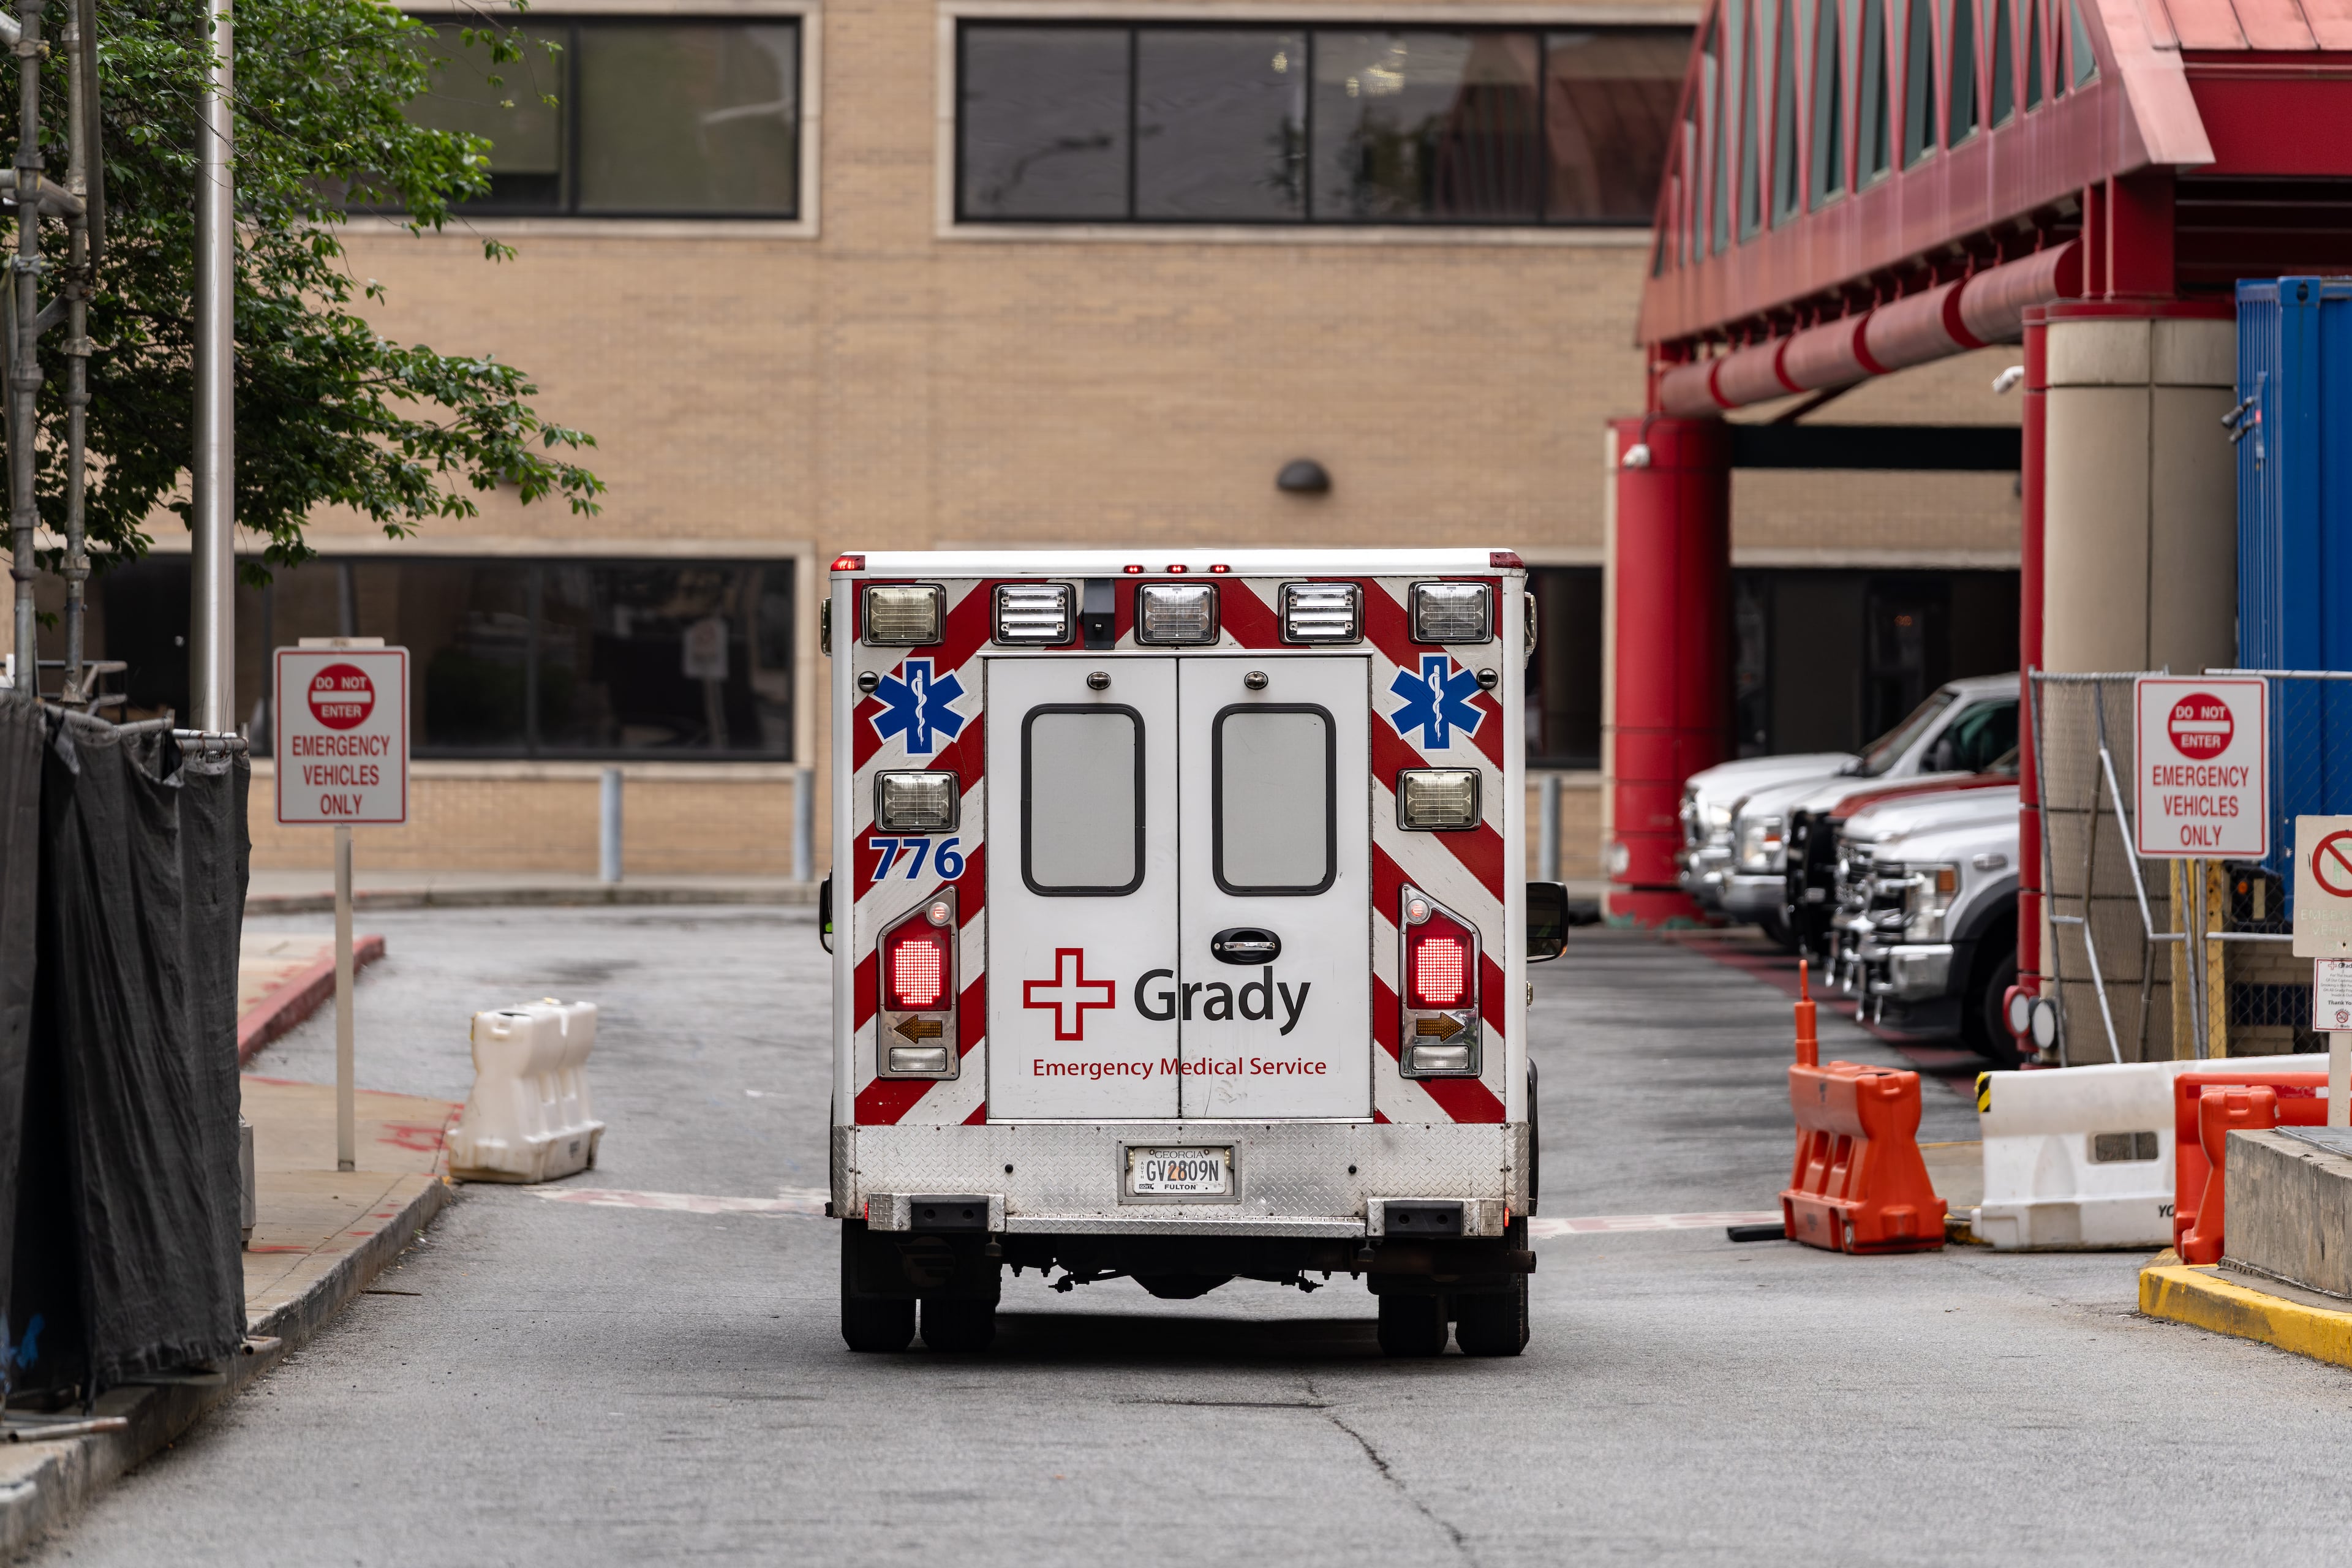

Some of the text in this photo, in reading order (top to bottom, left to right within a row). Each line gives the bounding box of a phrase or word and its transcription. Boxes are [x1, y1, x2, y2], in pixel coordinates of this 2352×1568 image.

[315, 676, 367, 689] DO NOT
[321, 705, 362, 718] ENTER
[2176, 706, 2226, 719] DO NOT
[292, 736, 390, 756] EMERGENCY
[2180, 734, 2221, 748] ENTER
[303, 764, 380, 786] VEHICLES
[2152, 765, 2249, 788] EMERGENCY
[320, 794, 363, 815] ONLY
[2163, 795, 2239, 817] VEHICLES
[2180, 824, 2222, 846] ONLY
[869, 837, 966, 881] 776
[2301, 909, 2352, 921] EMERG
[1134, 966, 1311, 1036] Grady
[1033, 1057, 1327, 1079] Emergency Medical Service
[1147, 1160, 1218, 1182] GV2809N
